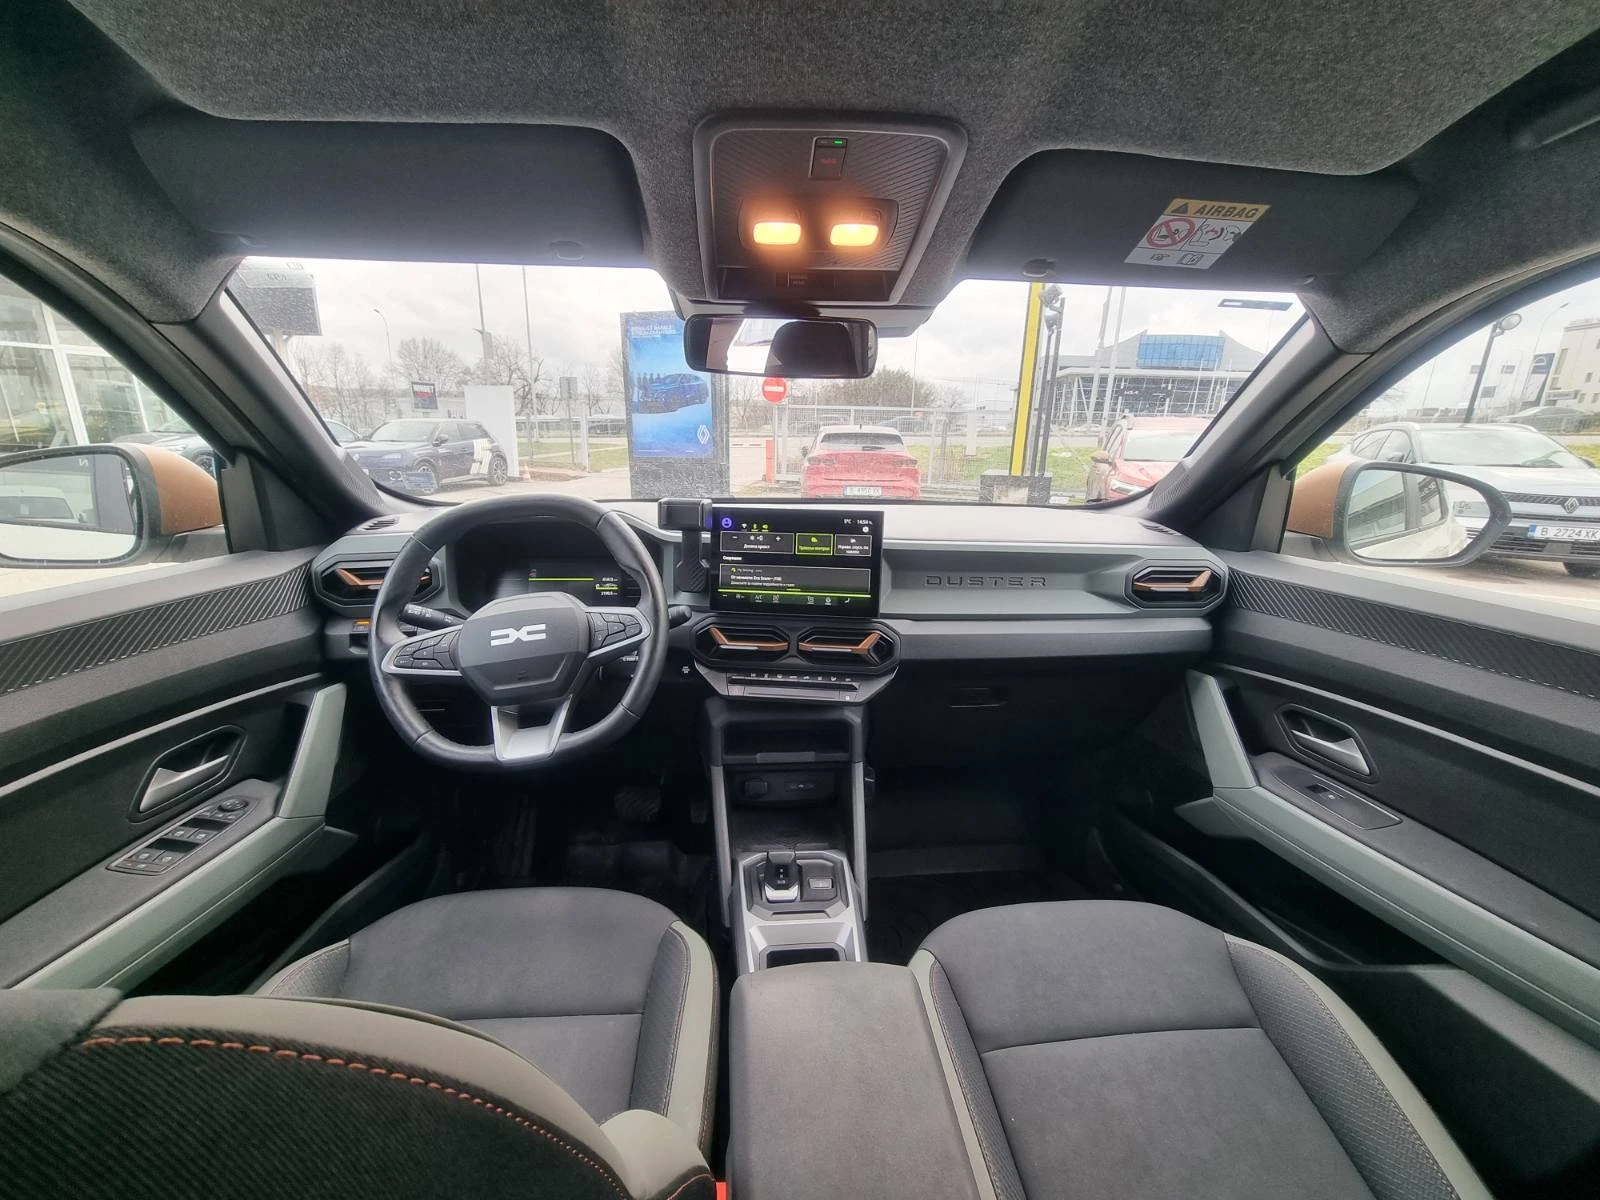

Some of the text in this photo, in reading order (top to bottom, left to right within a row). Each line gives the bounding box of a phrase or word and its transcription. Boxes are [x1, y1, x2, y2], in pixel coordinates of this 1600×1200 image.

[1193, 204, 1258, 219] AIRBAG
[1540, 527, 1549, 537] B
[1553, 527, 1582, 538] 2724
[926, 575, 1048, 588] DUSTER
